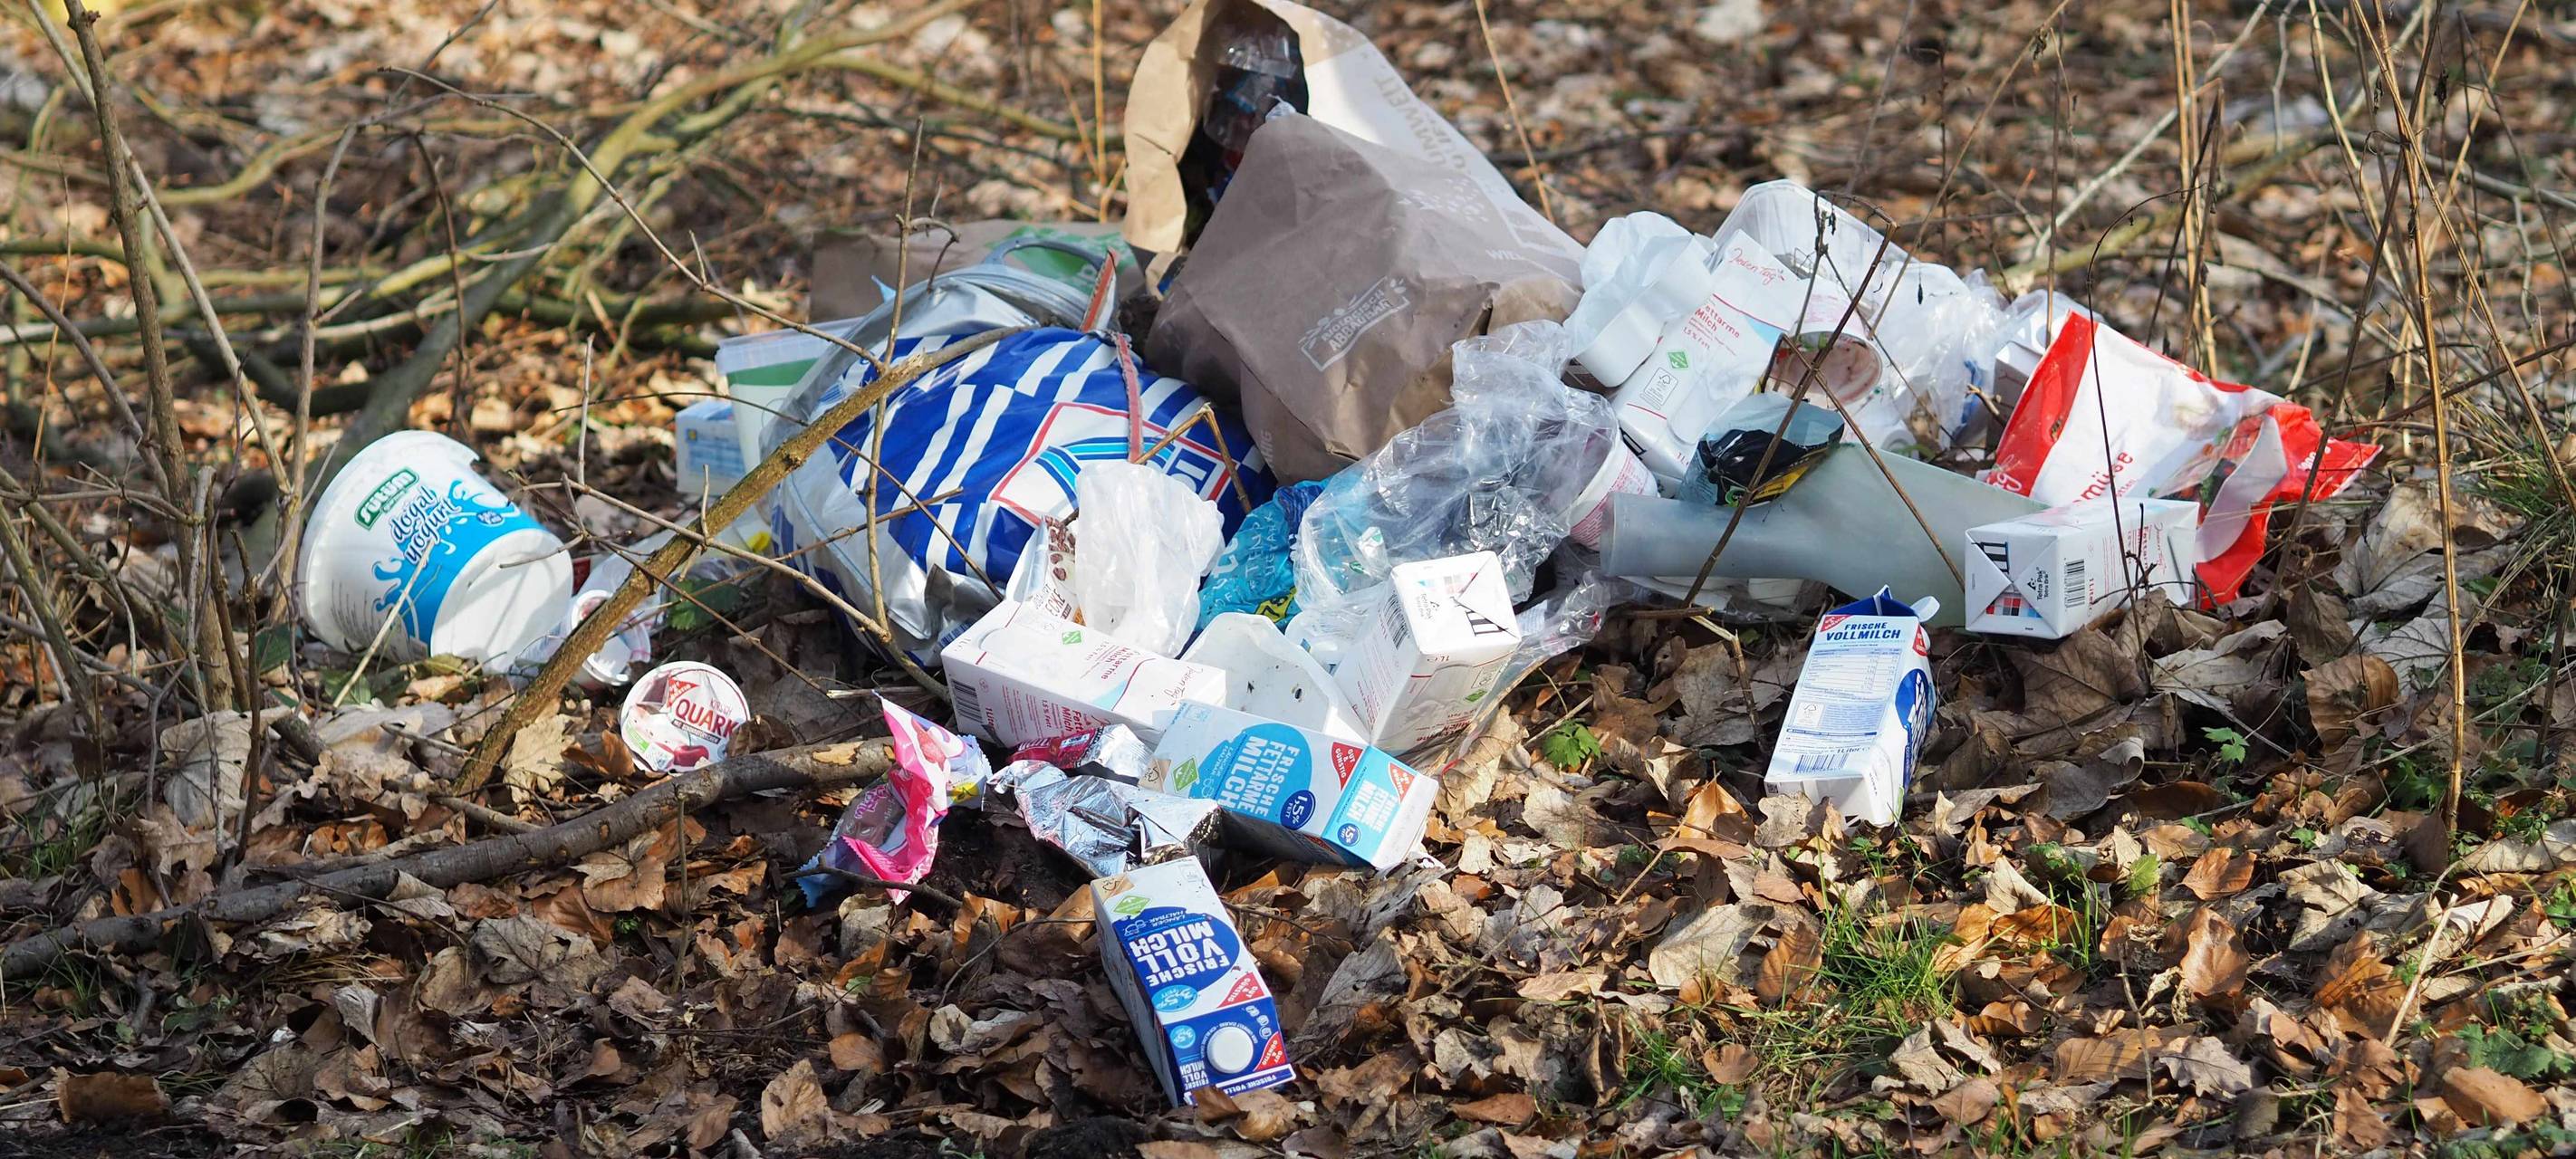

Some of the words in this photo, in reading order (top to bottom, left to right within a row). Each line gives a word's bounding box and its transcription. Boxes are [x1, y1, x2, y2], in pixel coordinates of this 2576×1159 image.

[1329, 298, 1394, 351] ABBAUBAR
[1695, 309, 1717, 331] Milch
[1045, 589, 1066, 617] ECKE
[1826, 629, 1901, 641] VOLLMILCH
[1844, 622, 1888, 631] FRISCHE
[675, 698, 740, 738] QUARK
[1061, 705, 1074, 732] Milch
[1334, 747, 1347, 779] GÜNSTIG
[1347, 748, 1356, 763] GUT
[1217, 735, 1268, 809] MILCH
[1241, 741, 1283, 817] FETTARME
[1254, 745, 1301, 818] FRISCHE
[1284, 802, 1294, 820] FETT
[1347, 780, 1378, 821] MILCH
[1129, 921, 1215, 957] MILCH
[1137, 938, 1226, 973] VOLL
[1146, 955, 1231, 987] FRISCHE
[1227, 977, 1251, 1002] GÜNSTIG
[1247, 985, 1258, 998] GUT
[1179, 1060, 1205, 1075] MILCH
[1274, 1051, 1283, 1064] GUT
[1181, 1072, 1207, 1082] VOLL
[1250, 1075, 1277, 1088] FRISCHE
